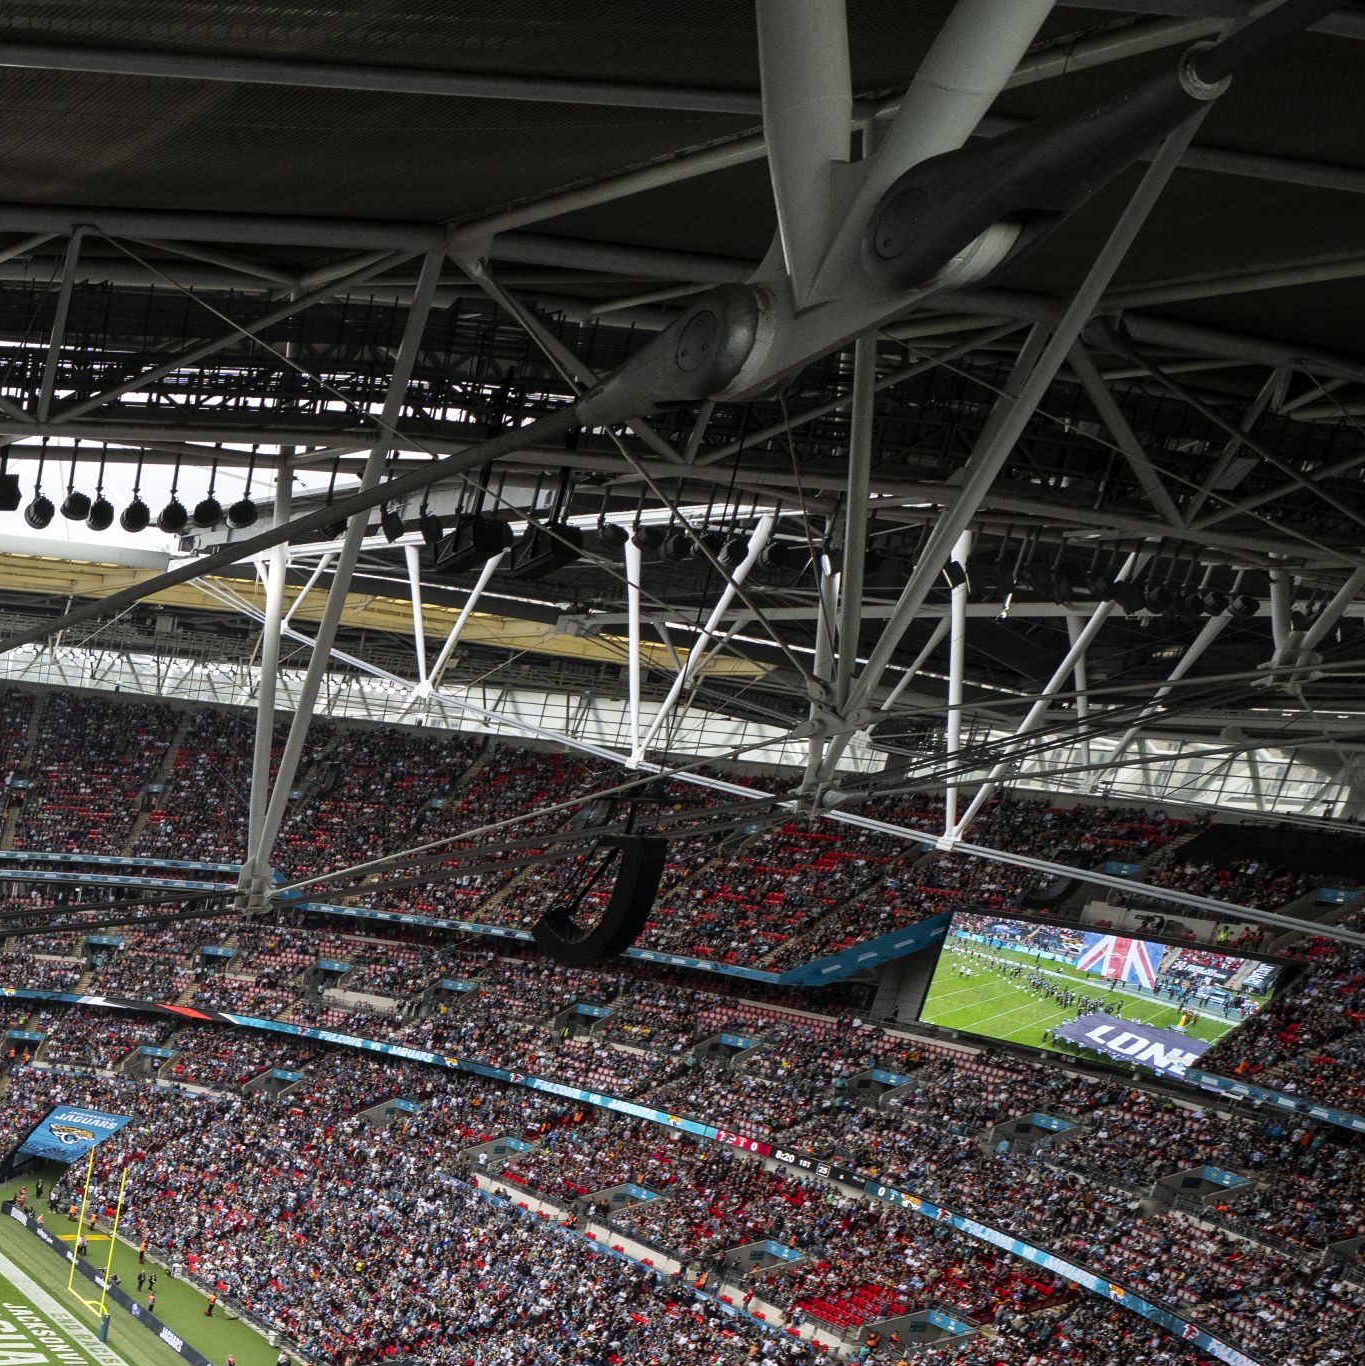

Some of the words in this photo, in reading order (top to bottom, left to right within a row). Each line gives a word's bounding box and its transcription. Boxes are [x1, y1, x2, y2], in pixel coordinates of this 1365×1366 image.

[54, 1113, 118, 1130] JAGUARS
[775, 1150, 796, 1164] 8:20
[50, 1311, 83, 1331] END
[159, 1326, 183, 1353] JAGUARS
